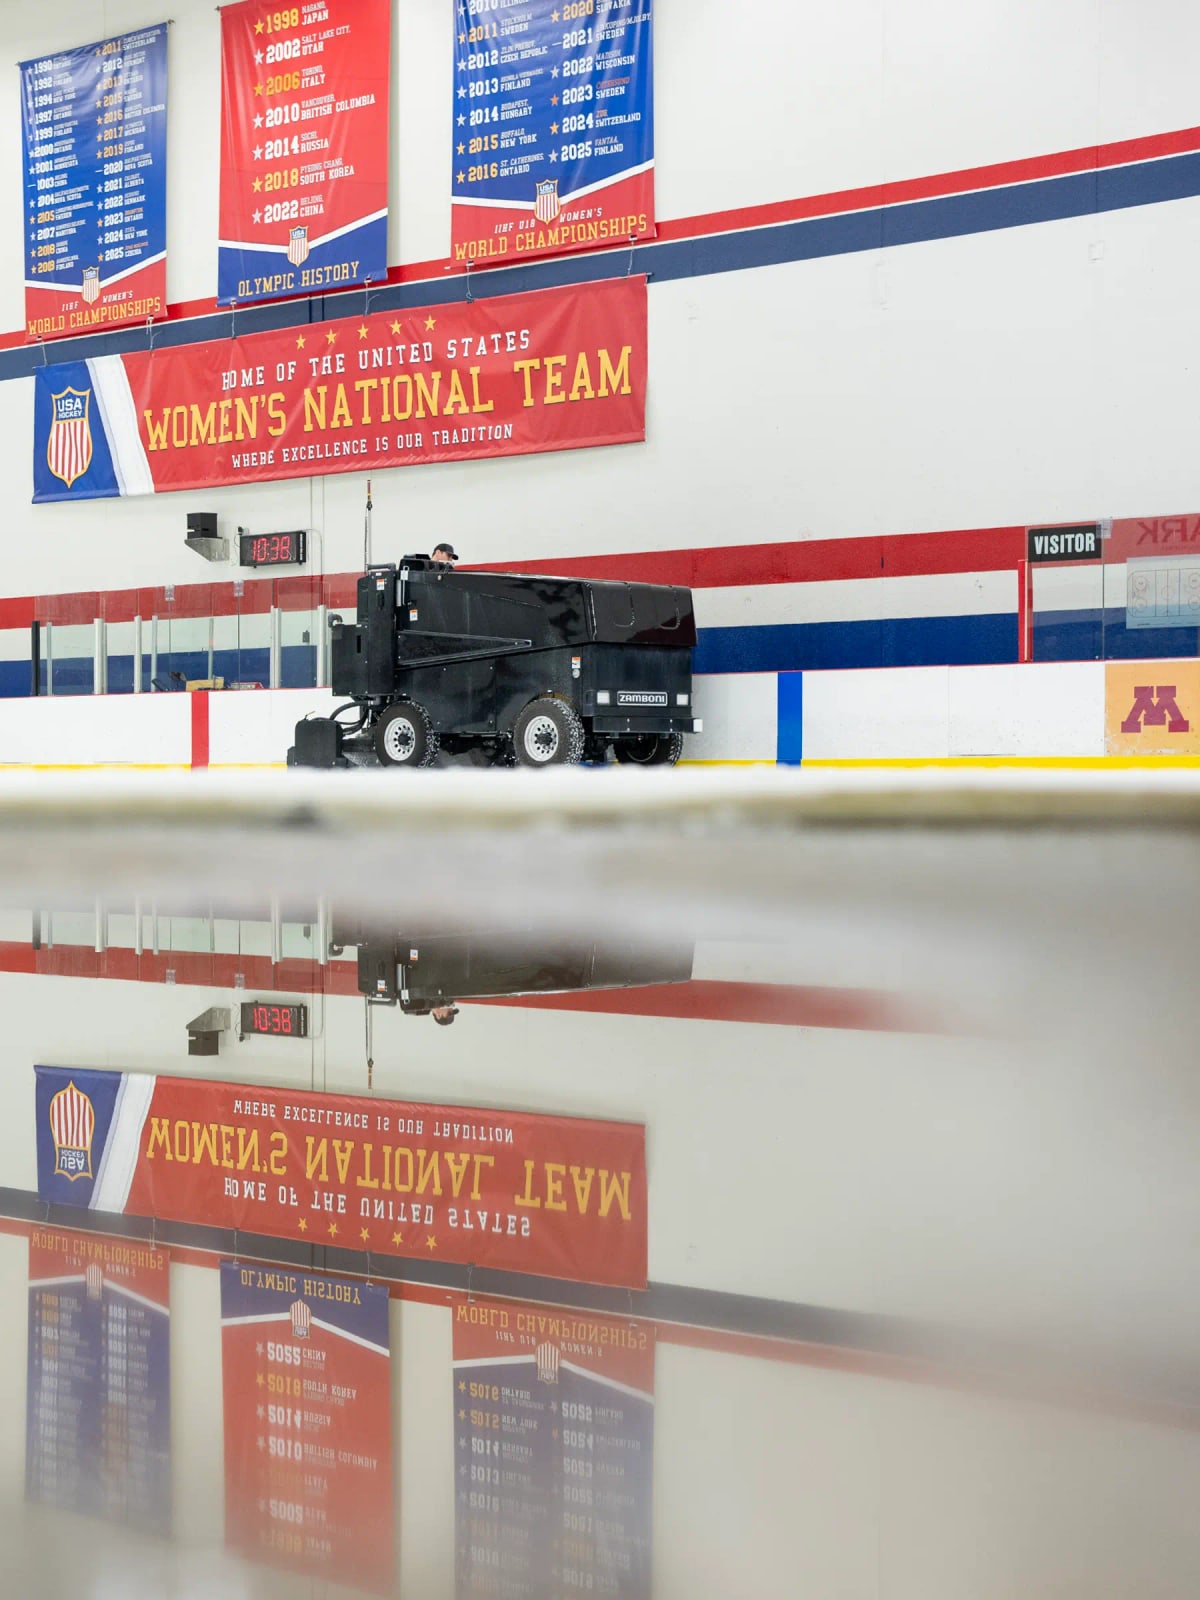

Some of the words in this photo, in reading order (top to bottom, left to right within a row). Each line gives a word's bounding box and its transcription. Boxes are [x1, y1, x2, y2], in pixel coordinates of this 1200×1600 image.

[470, 0, 498, 15] 2010
[563, 1, 593, 21] 2020
[266, 8, 299, 34] 1998
[302, 9, 328, 26] JAPAN
[468, 23, 497, 43] 2011
[500, 22, 528, 36] SWEDEN
[596, 28, 624, 42] SWEDEN
[563, 28, 593, 49] 2021
[102, 40, 121, 55] 2011
[266, 38, 300, 64] 2002
[302, 41, 323, 55] UTAH
[103, 58, 122, 73] 2012
[468, 50, 498, 70] 2012
[563, 56, 593, 77] 2022
[596, 55, 636, 71] WISCONSIN
[34, 77, 52, 91] 1992
[266, 71, 300, 95] 2006
[301, 74, 326, 88] ITALY
[470, 78, 498, 97] 2013
[500, 78, 531, 92] FINLAND
[34, 94, 52, 107] 1994
[103, 92, 123, 107] 2015
[562, 84, 593, 105] 2023
[596, 86, 625, 100] SWEDEN
[301, 105, 332, 120] BRITISH
[335, 94, 375, 113] COLUMBIA
[501, 106, 532, 120] HUNGARY
[35, 110, 52, 124] 1997
[103, 109, 123, 124] 2016
[265, 103, 300, 128] 2010
[470, 106, 498, 126] 2014
[562, 113, 594, 134] 2024
[595, 112, 641, 128] SWITZERLAND
[35, 127, 53, 141] 1999
[103, 126, 123, 141] 2017
[500, 138, 516, 149] NEW
[520, 133, 537, 144] YORK
[103, 144, 123, 158] 2019
[265, 135, 299, 160] 2014
[301, 138, 328, 153] RUSSIA
[468, 134, 498, 154] 2015
[561, 142, 592, 162] 2025
[594, 144, 623, 156] FINLAND
[104, 161, 123, 175] 2020
[300, 171, 325, 185] SOUTH
[329, 165, 354, 180] KOREA
[468, 163, 498, 182] 2016
[500, 164, 530, 177] ONTARIO
[104, 178, 123, 192] 2021
[264, 168, 298, 192] 2018
[104, 195, 123, 209] 2022
[264, 200, 298, 224] 2022
[300, 204, 324, 217] CHINA
[104, 212, 123, 226] 2023
[494, 223, 514, 234] IIHF
[519, 218, 535, 229] U18
[559, 208, 602, 223] WOMEN'S
[104, 230, 123, 244] 2024
[455, 236, 507, 260] WORLD
[516, 214, 647, 251] CHAMPIONSHIPS
[105, 247, 124, 261] 2025
[238, 273, 294, 297] OLYMPIC
[301, 261, 359, 286] HISTORY
[102, 290, 133, 303] WOMEN'S
[28, 315, 65, 336] WORLD
[70, 297, 160, 328] CHAMPIONSHIPS
[222, 366, 265, 391] HOME
[276, 361, 297, 382] OF
[309, 354, 345, 376] THE
[358, 342, 433, 370] UNITED
[447, 329, 531, 359] STATES
[58, 397, 82, 413] USA
[144, 391, 286, 451] WOMEN'S
[304, 366, 495, 433] NATIONAL
[514, 345, 632, 408] TEAM
[58, 410, 82, 419] HOCKEY
[232, 450, 274, 469] WHERE
[282, 437, 367, 464] EXCELLENCE
[376, 436, 388, 452] IS
[397, 432, 423, 449] OUR
[433, 423, 513, 447] TRADITION
[251, 536, 291, 562] 10:38
[1034, 533, 1095, 555] VISITOR
[619, 694, 665, 703] ZAMBONI
[1121, 686, 1189, 733] M
